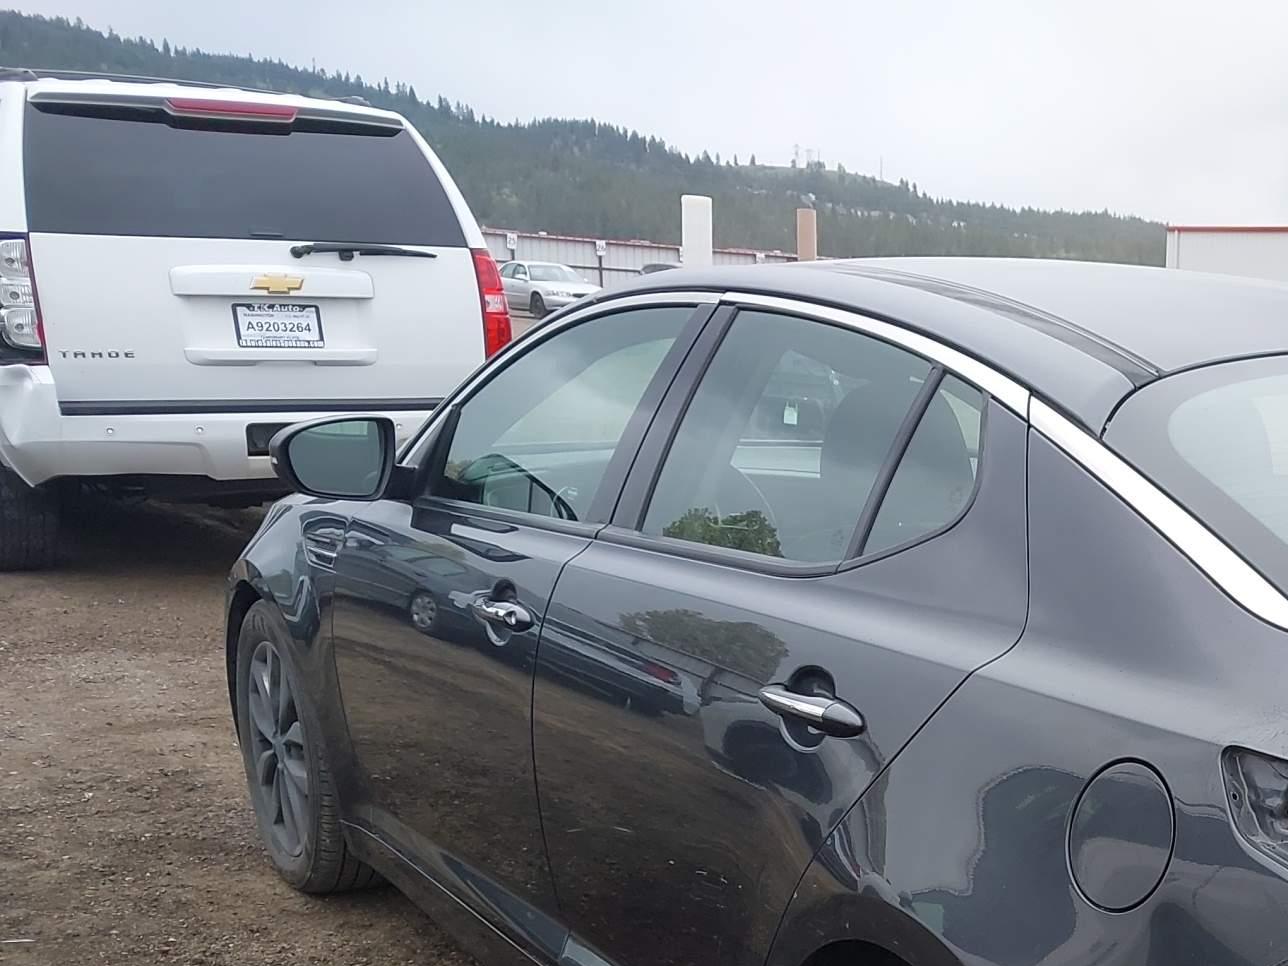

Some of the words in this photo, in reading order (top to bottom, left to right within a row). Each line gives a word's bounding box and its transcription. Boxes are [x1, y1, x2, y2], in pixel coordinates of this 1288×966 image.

[273, 304, 300, 313] Auto
[246, 320, 312, 333] A9203264
[58, 350, 136, 359] TAHOE
